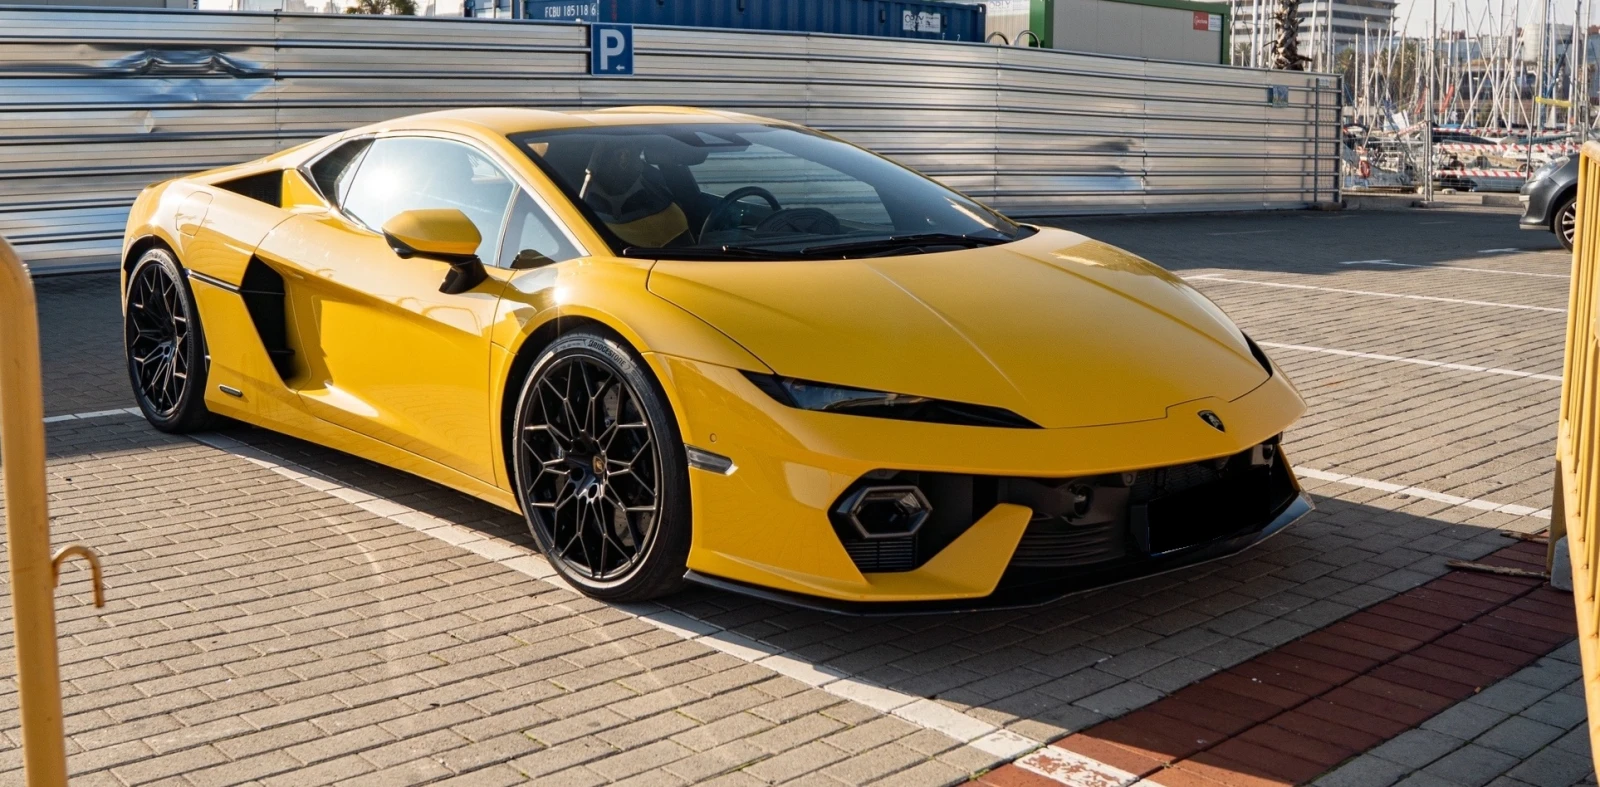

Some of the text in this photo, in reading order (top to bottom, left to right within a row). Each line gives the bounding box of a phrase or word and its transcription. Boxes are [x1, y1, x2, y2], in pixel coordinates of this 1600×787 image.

[545, 6, 561, 18] FCBU
[564, 5, 589, 16] 185118
[600, 29, 625, 70] P
[588, 339, 626, 366] BRIDGESTONE
